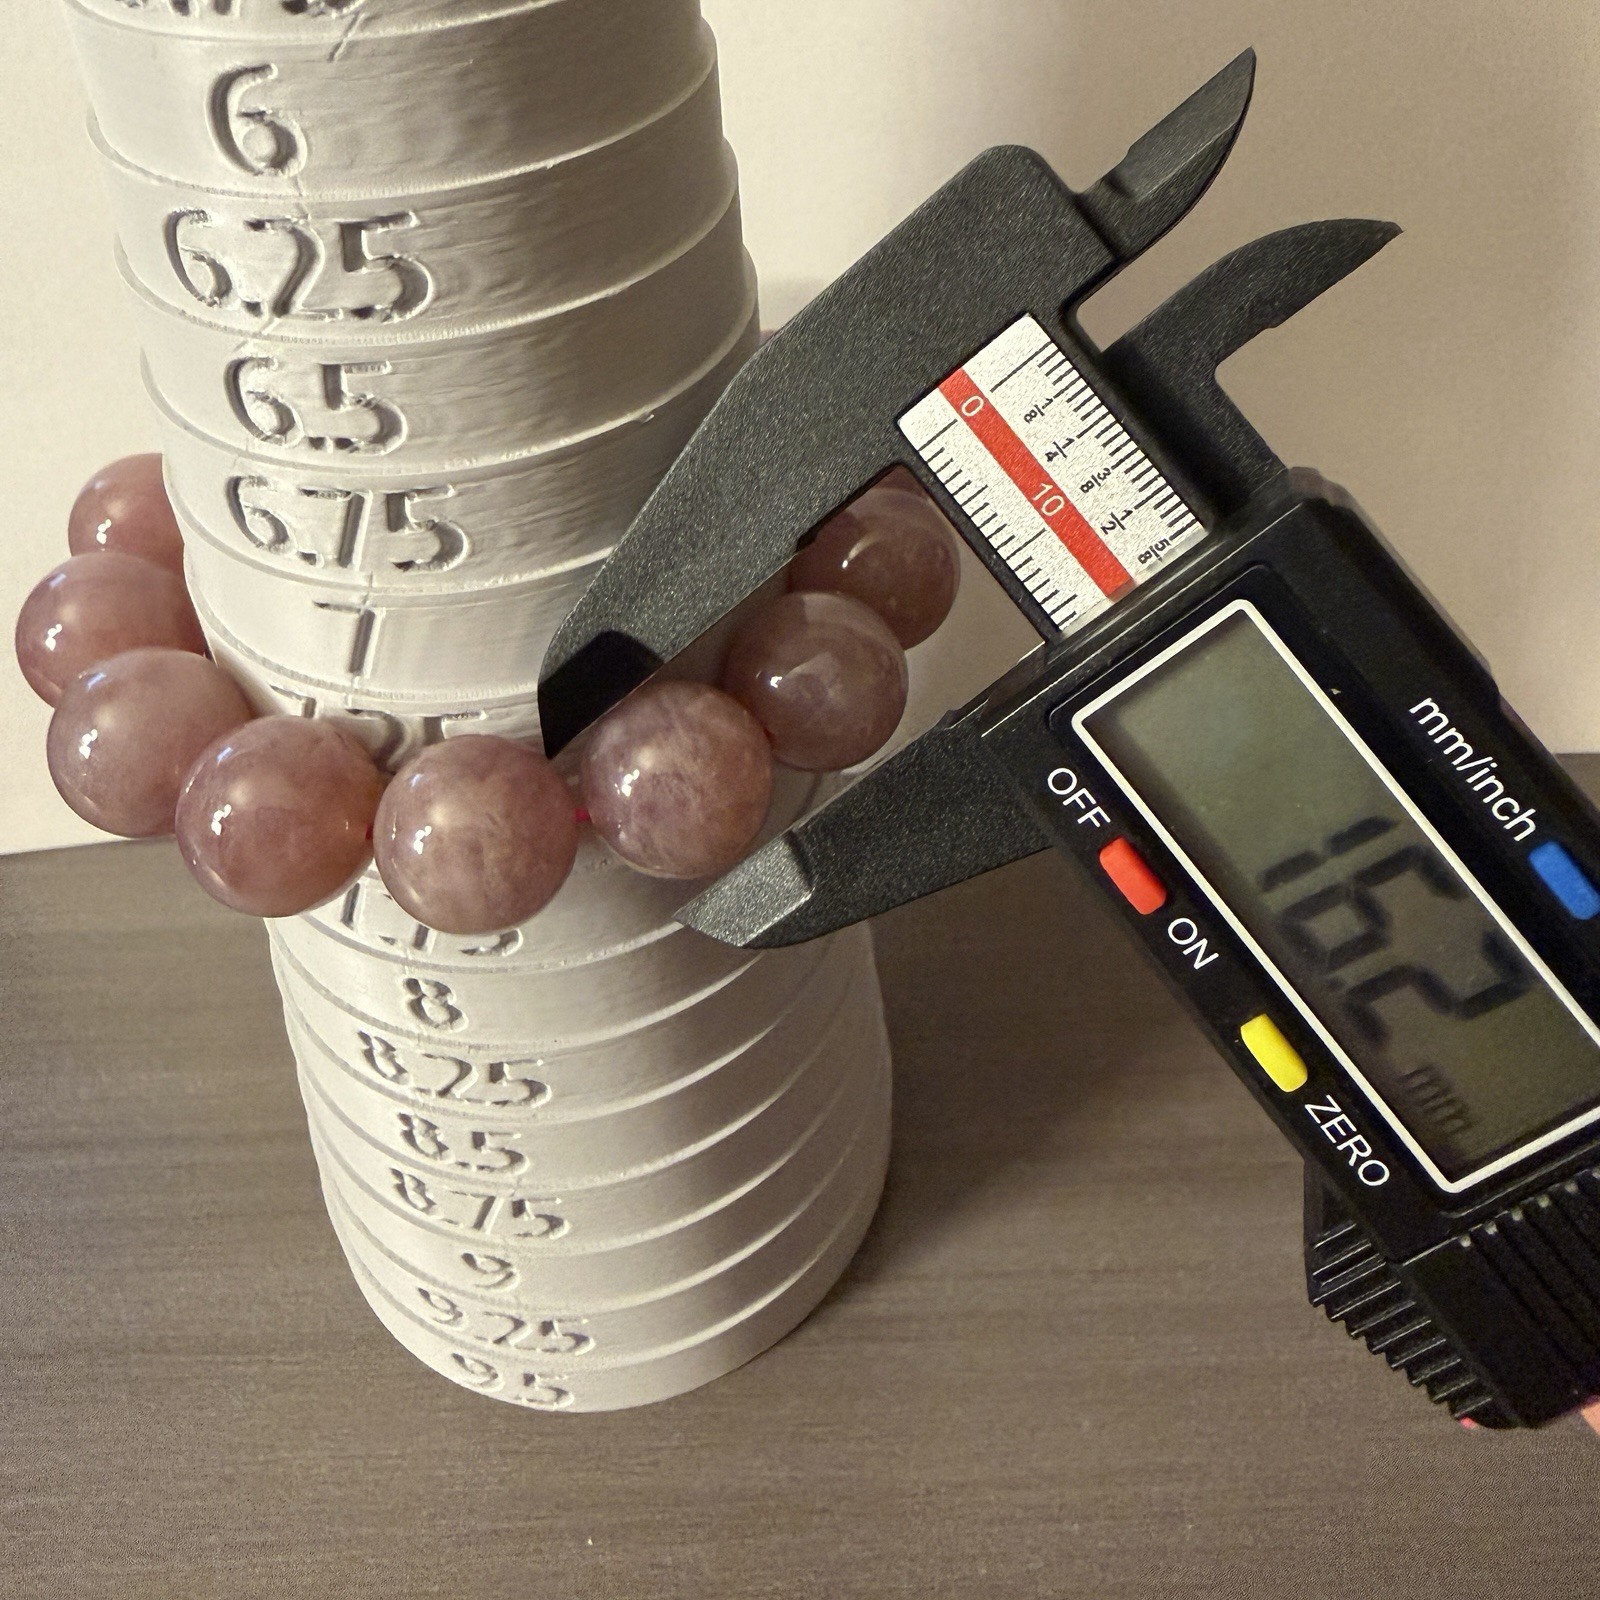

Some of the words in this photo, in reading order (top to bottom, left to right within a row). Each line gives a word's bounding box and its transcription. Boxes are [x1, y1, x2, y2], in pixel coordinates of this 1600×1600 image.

[207, 62, 308, 178] 6
[162, 207, 435, 324] 6.25
[223, 354, 410, 457] 6.5
[961, 396, 984, 417] 0
[226, 474, 471, 572] 6.75
[1031, 482, 1066, 517] 10
[312, 598, 386, 678] 7
[1046, 767, 1111, 828] OFF
[1409, 697, 1538, 843] mm/inch
[1167, 917, 1219, 970] ON
[403, 976, 467, 1033] 8
[1304, 1094, 1391, 1188] ZERO
[460, 1252, 520, 1292] 9
